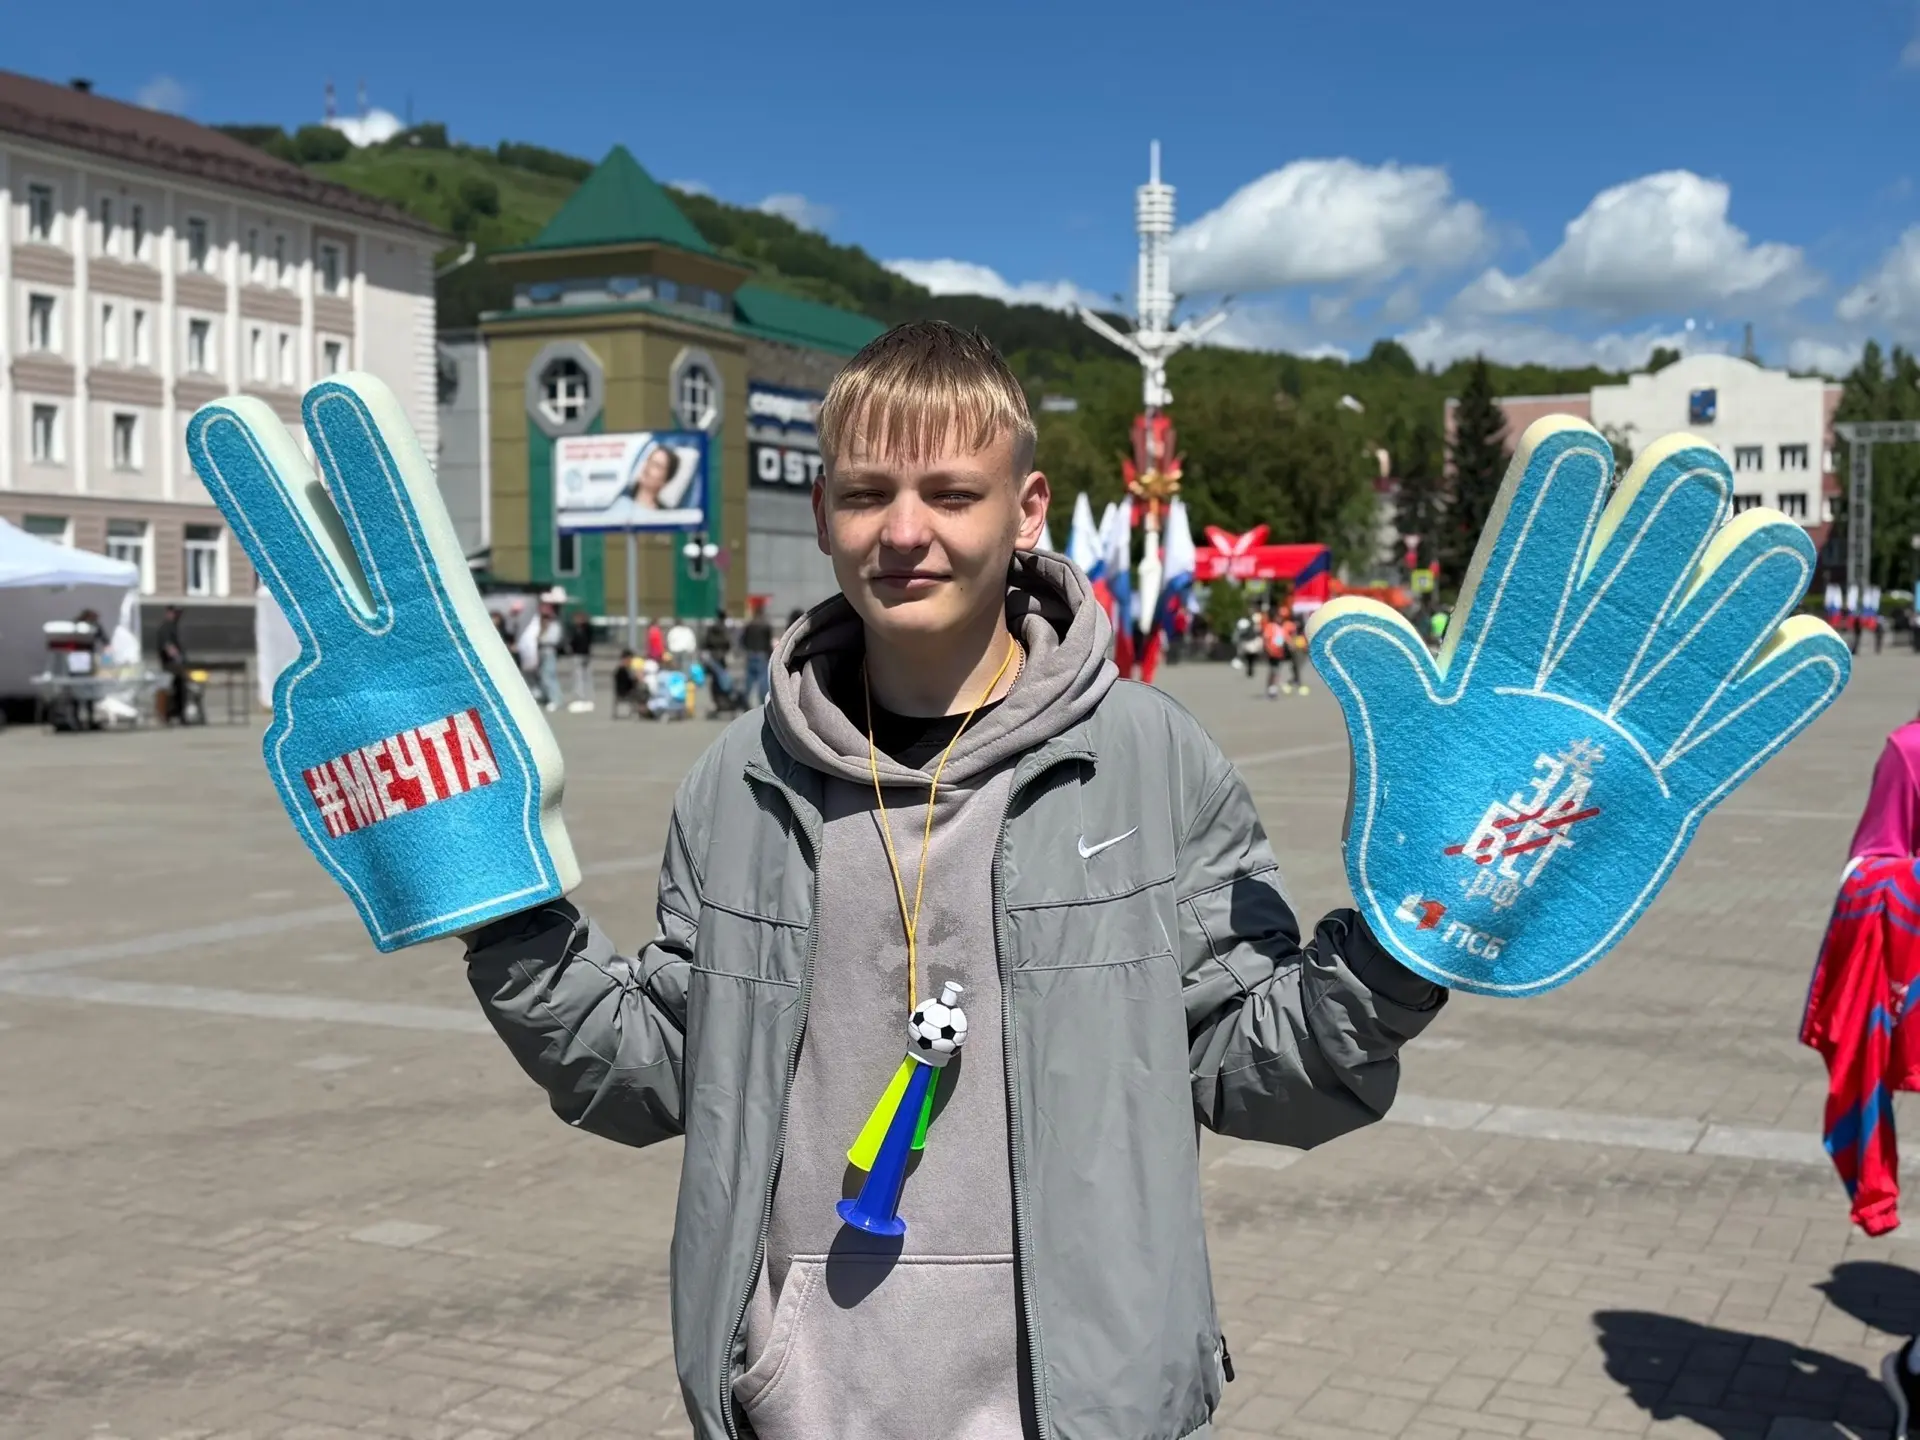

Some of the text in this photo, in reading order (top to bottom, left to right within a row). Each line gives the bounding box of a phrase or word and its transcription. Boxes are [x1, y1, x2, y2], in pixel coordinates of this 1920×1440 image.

[308, 709, 501, 839] #МЕЧТА
[1508, 753, 1592, 836] ЗА
[1462, 801, 1576, 888] БЕГ
[1442, 920, 1507, 960] ПСБ
